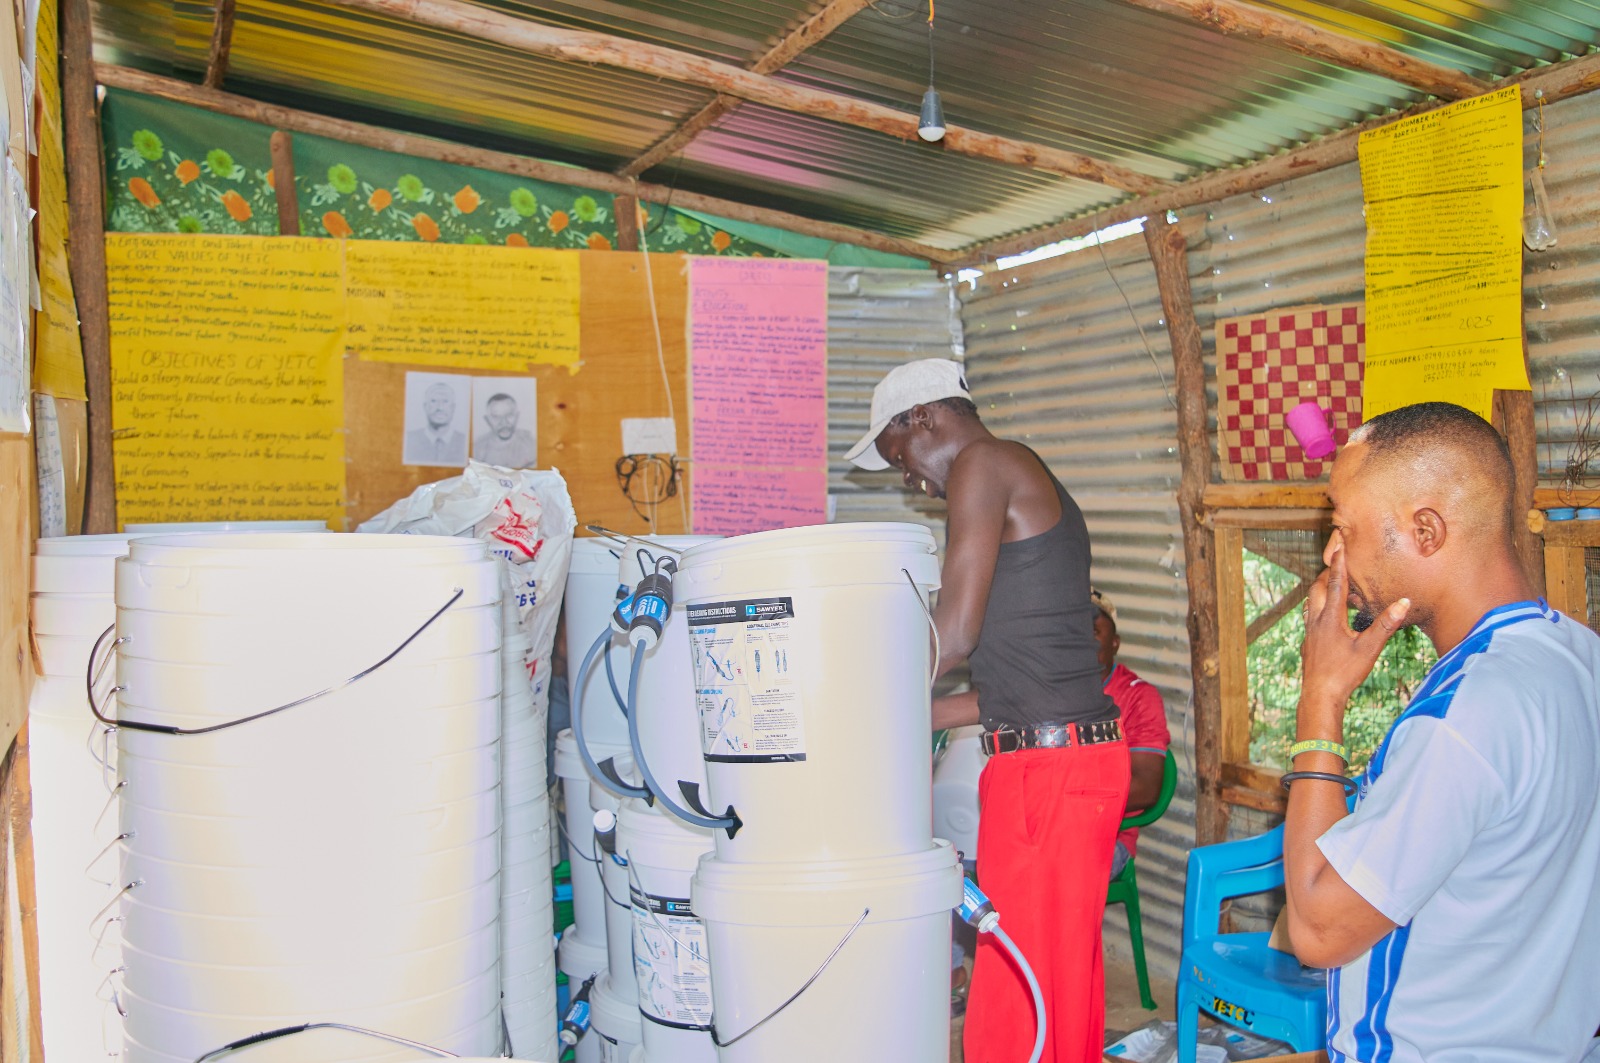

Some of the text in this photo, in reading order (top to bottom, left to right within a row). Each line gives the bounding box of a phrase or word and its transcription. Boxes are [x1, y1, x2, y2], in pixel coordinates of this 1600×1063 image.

[1401, 115, 1430, 128] NUMBER
[1456, 100, 1477, 111] STAFF
[1497, 88, 1516, 99] THEIR
[127, 249, 160, 261] CORE
[169, 250, 213, 262] VALUES
[1459, 315, 1496, 330] 2025
[141, 349, 318, 371] OBJECTIVES OF YETC
